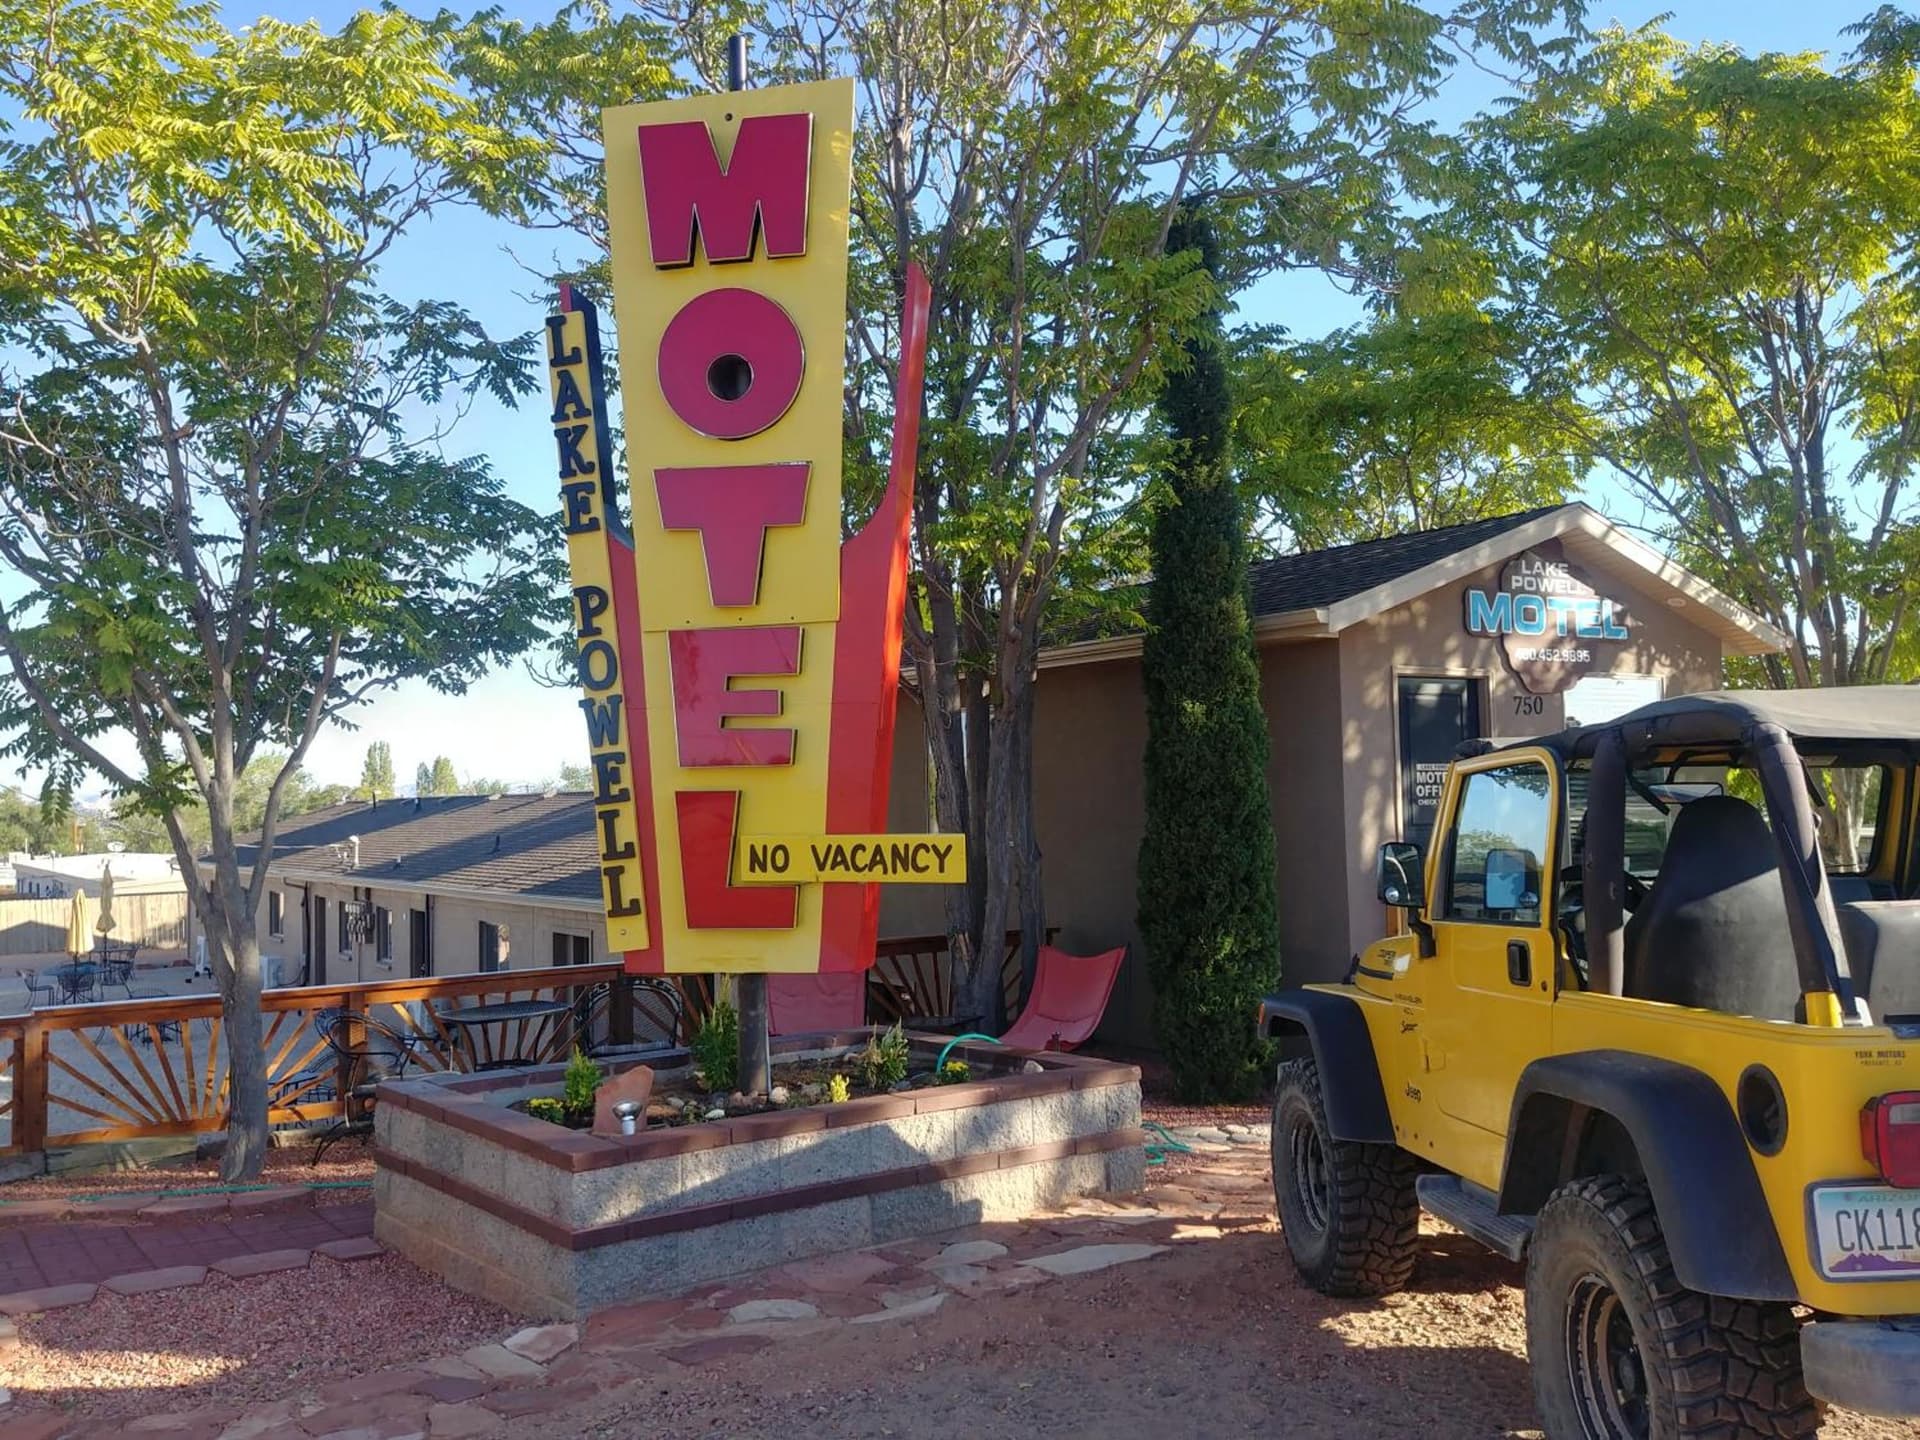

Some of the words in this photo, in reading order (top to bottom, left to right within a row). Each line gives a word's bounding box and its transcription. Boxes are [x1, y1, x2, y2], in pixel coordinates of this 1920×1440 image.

[638, 112, 813, 930] MOTEL
[1521, 560, 1568, 577] LAKE
[546, 315, 600, 534] LAKE
[573, 585, 641, 918] POWELL
[1469, 590, 1629, 640] MOTEL
[1513, 695, 1543, 715] 750
[749, 843, 790, 874] NO
[811, 843, 953, 875] VACANCY
